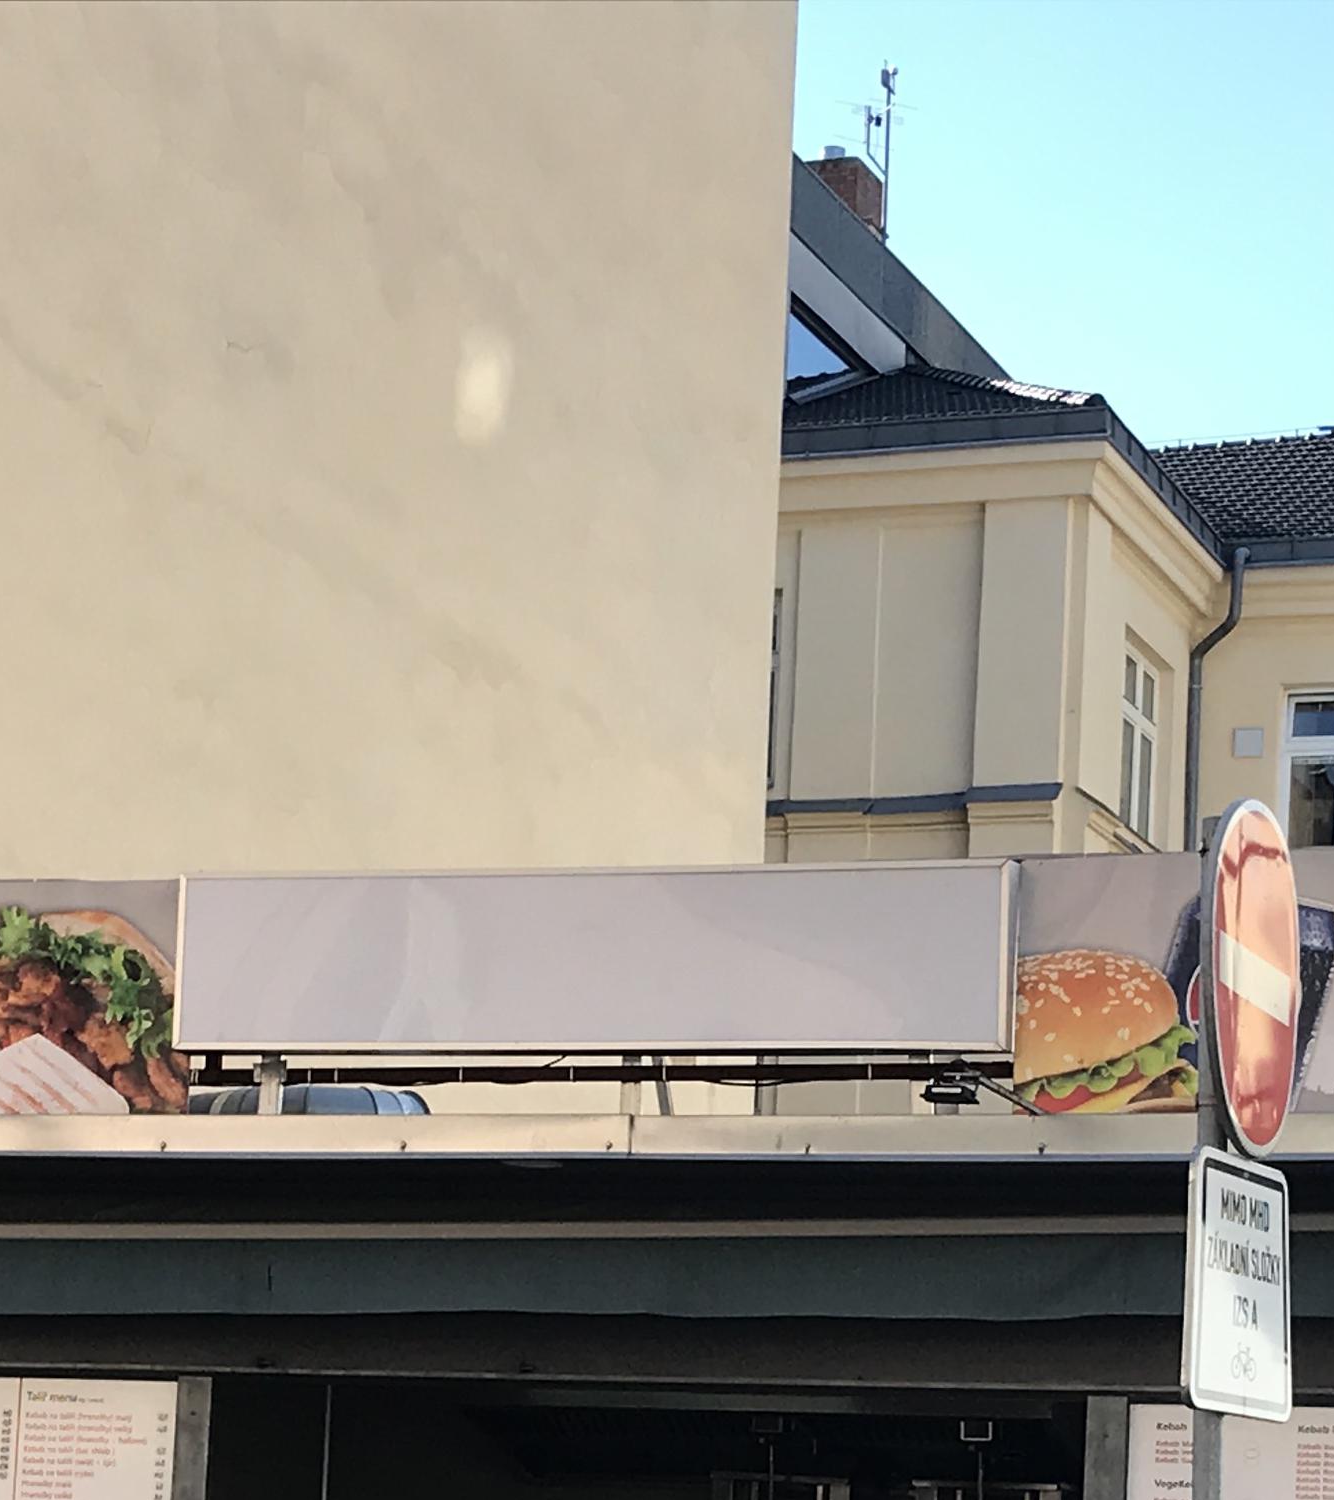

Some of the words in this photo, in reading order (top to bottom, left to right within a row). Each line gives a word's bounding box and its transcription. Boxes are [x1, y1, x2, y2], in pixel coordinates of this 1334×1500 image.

[1220, 1188, 1246, 1226] MIMO
[1207, 1231, 1249, 1277] ZÁKLADNÍ
[1252, 1299, 1258, 1330] A
